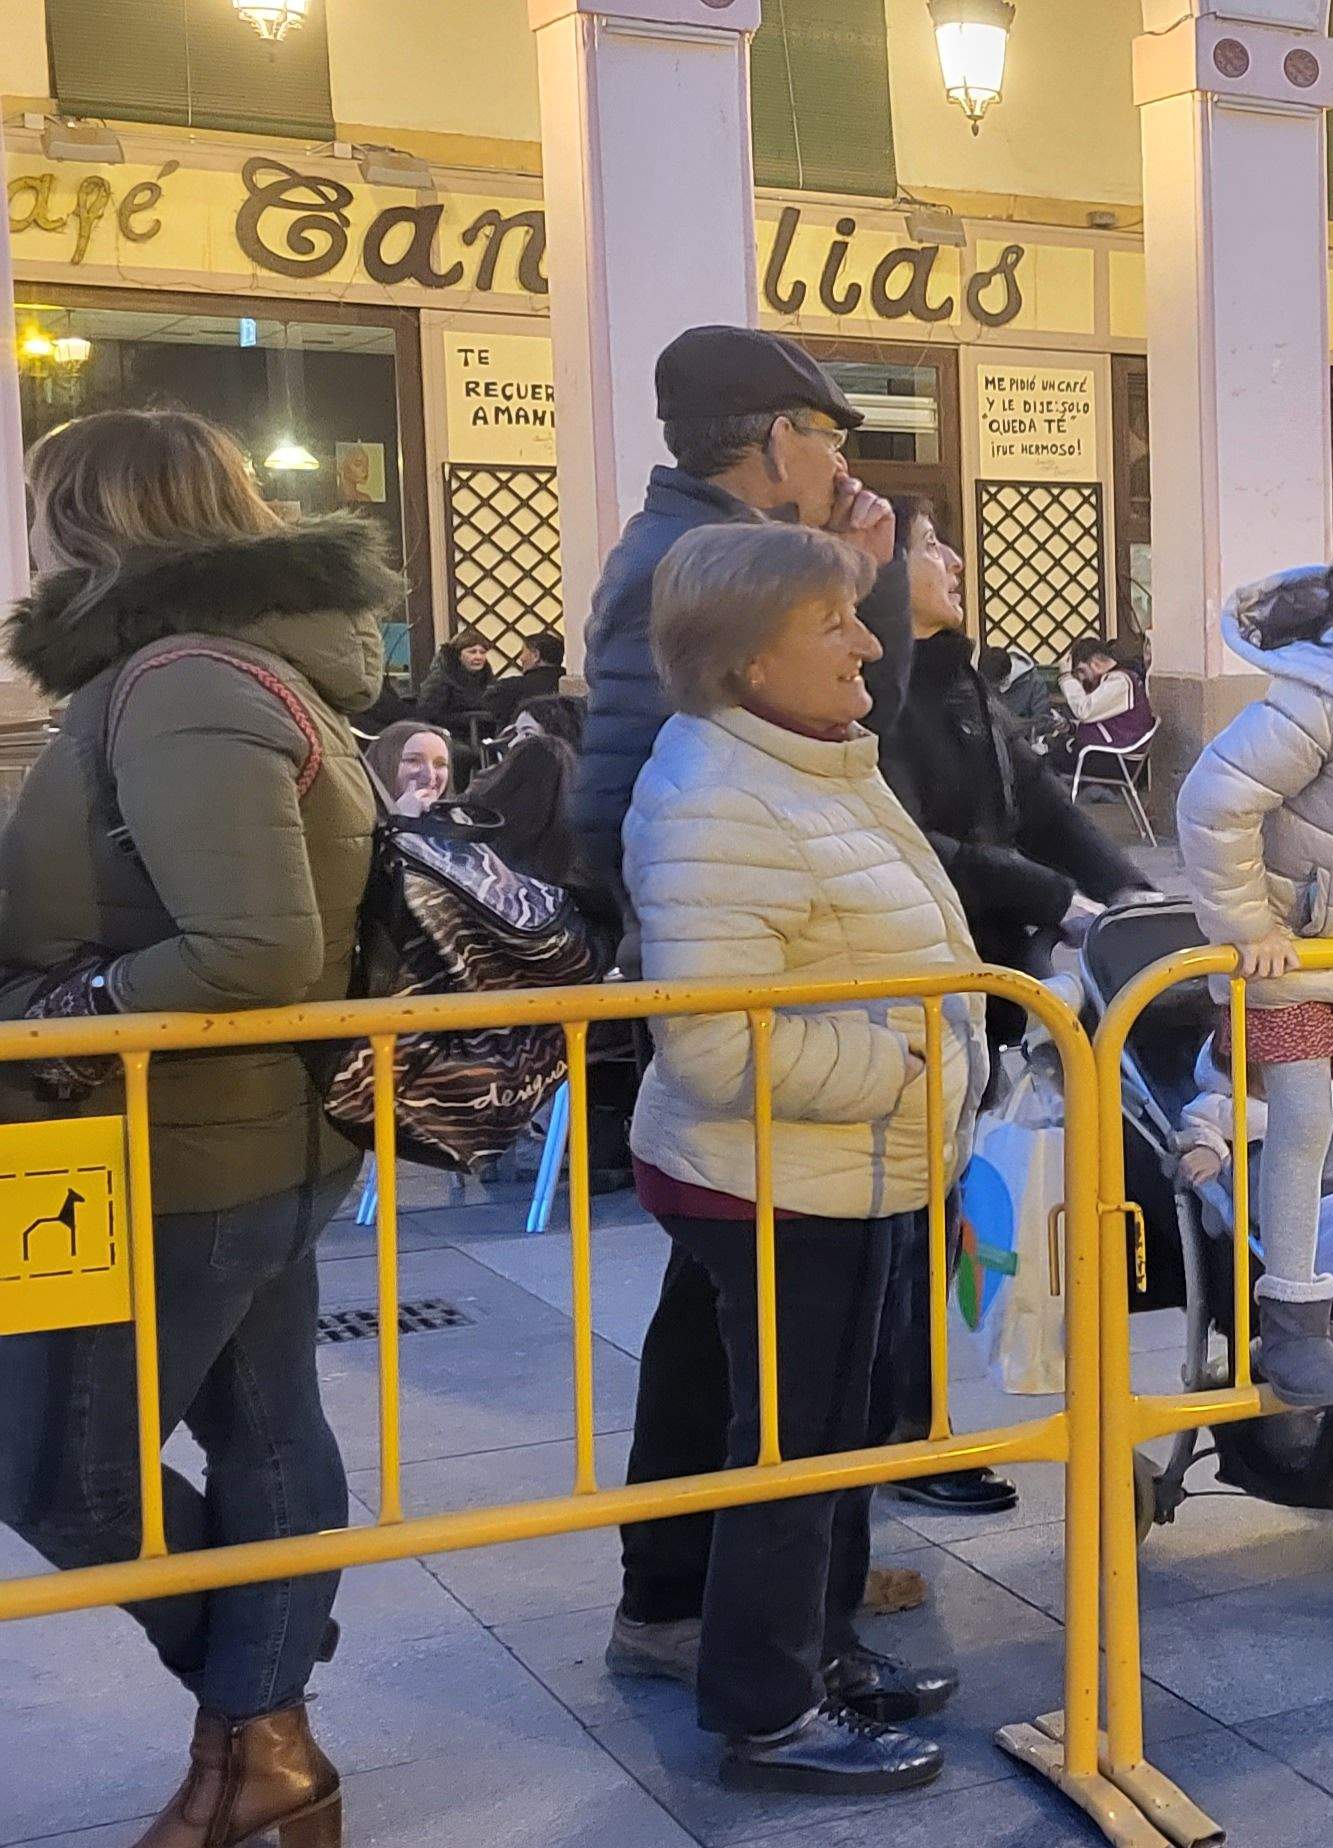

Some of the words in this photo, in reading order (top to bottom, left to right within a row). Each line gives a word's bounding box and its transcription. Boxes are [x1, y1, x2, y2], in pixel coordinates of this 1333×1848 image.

[7, 159, 180, 265] afé
[457, 348, 490, 367] TE
[465, 380, 555, 402] RECUER
[984, 376, 1006, 391] ME
[1041, 380, 1055, 391] UN
[1057, 376, 1088, 393] CAFÉ
[986, 397, 995, 412] Y
[1002, 398, 1015, 412] LE
[472, 406, 556, 428] AMAN
[1021, 438, 1082, 457] HERMOSO!
[473, 1060, 568, 1112] desigua
